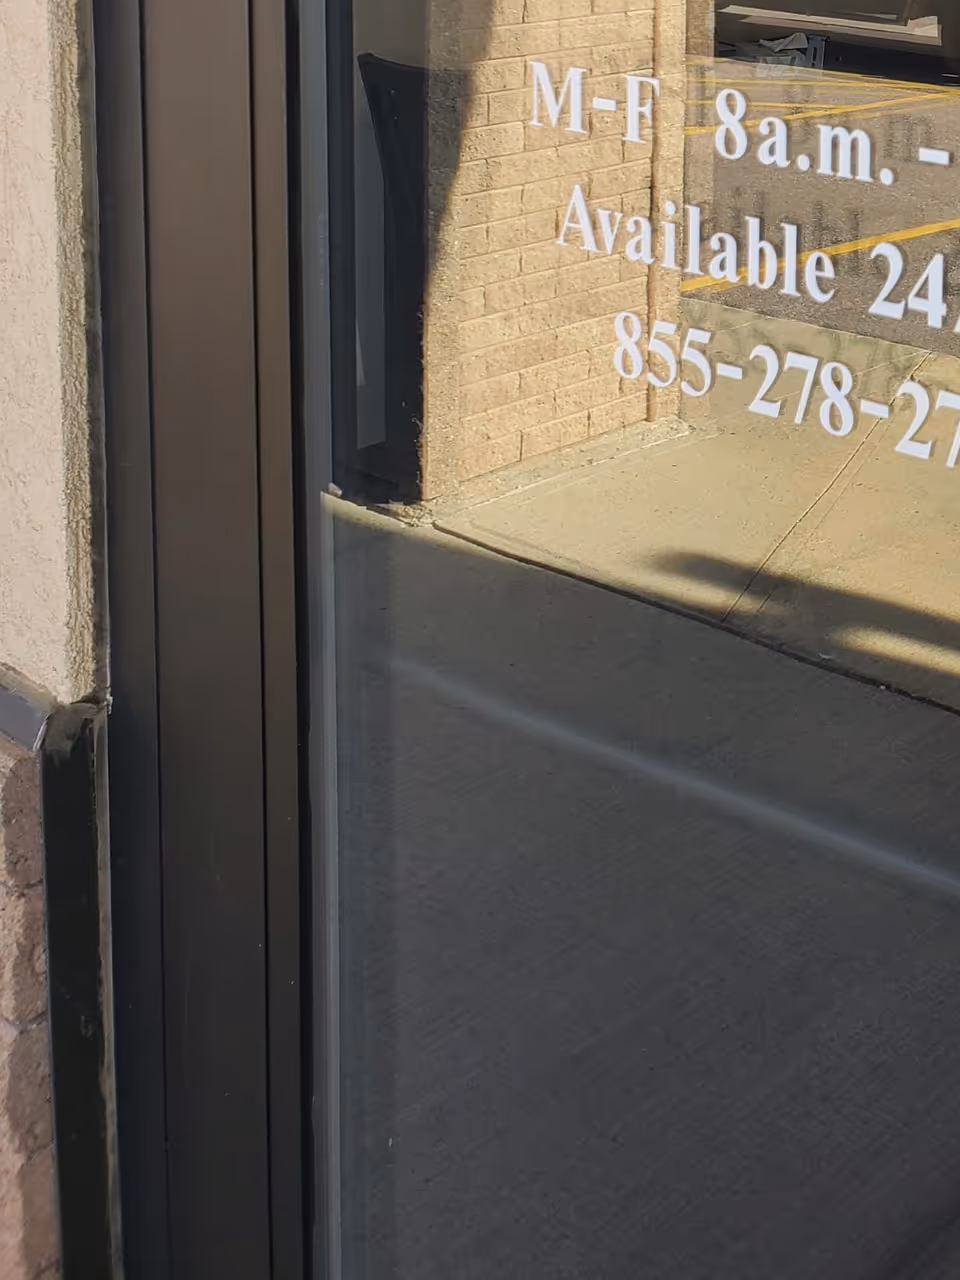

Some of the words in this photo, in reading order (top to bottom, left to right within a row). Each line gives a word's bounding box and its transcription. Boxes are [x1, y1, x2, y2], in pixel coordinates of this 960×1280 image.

[528, 61, 660, 144] M-F
[714, 87, 895, 186] 8a.m.
[555, 184, 836, 304] Available
